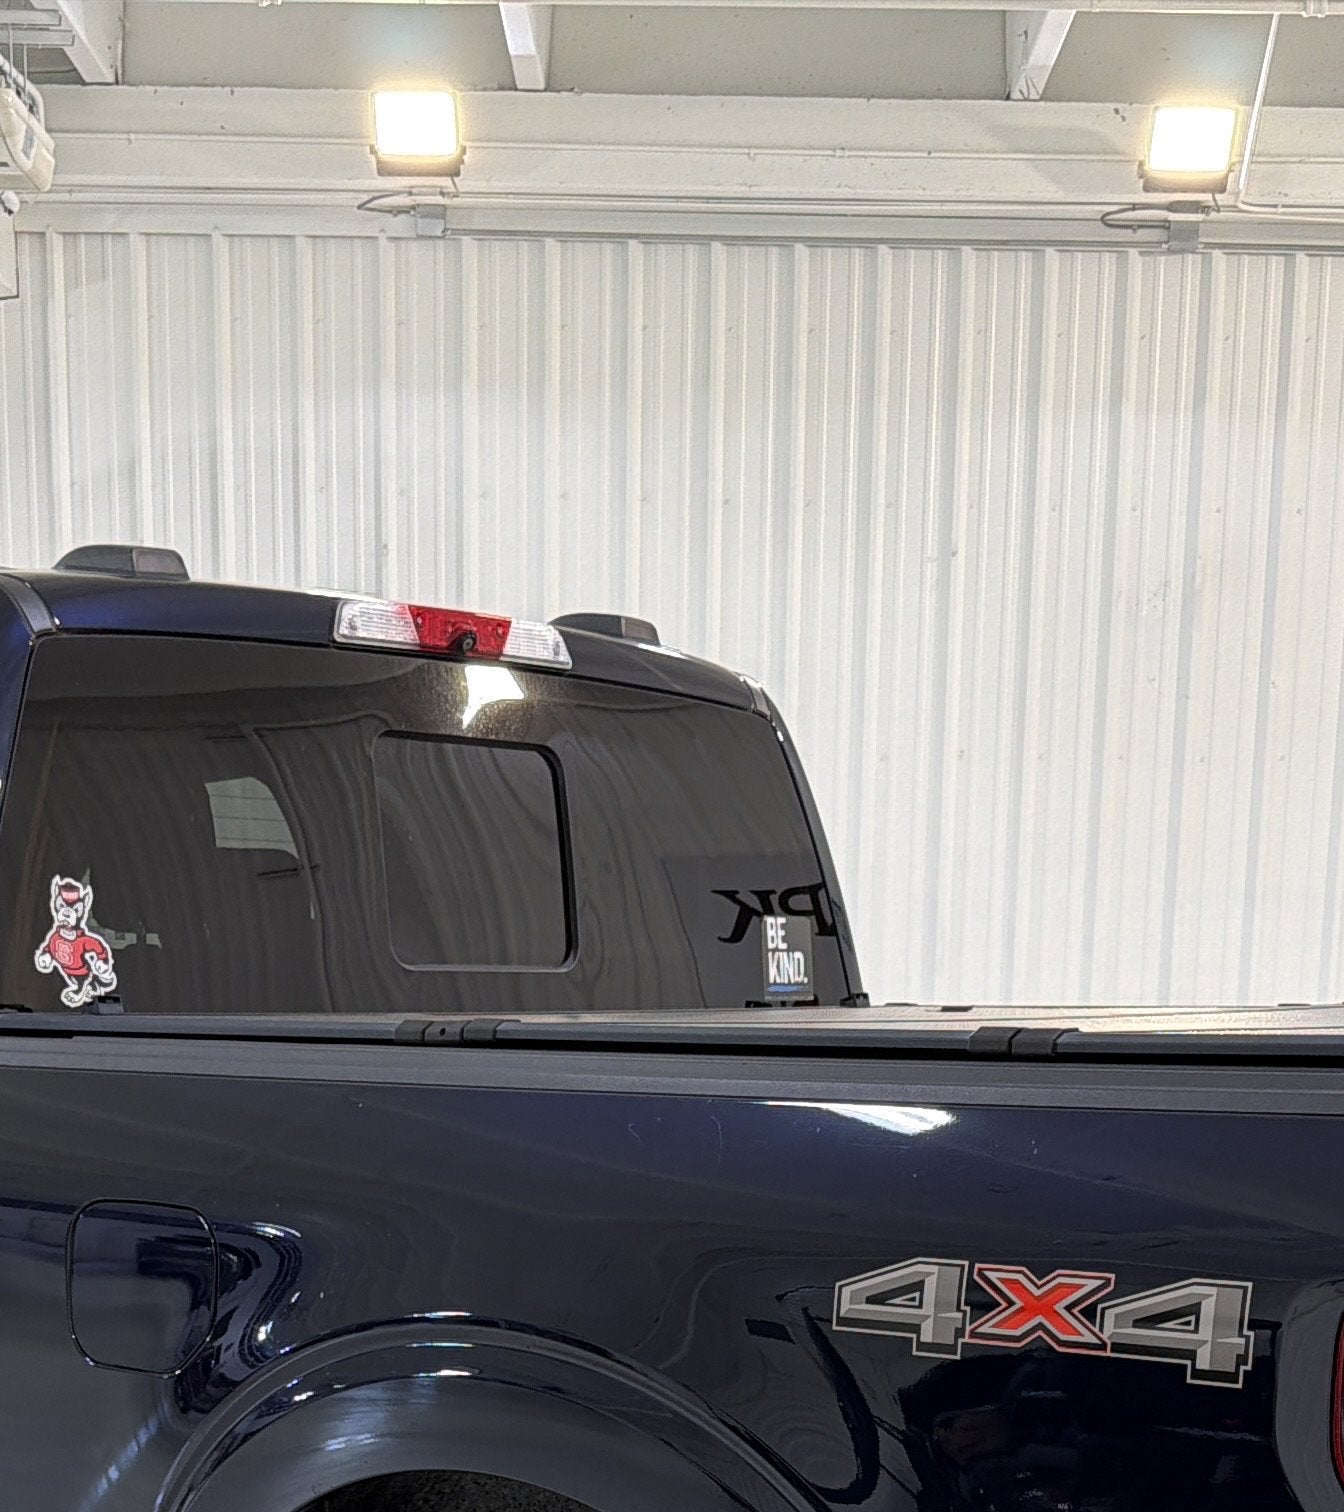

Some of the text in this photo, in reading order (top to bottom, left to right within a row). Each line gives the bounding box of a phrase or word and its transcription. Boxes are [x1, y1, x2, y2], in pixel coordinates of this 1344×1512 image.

[766, 916, 788, 949] BE
[767, 951, 808, 984] KIND.
[833, 1257, 1254, 1388] 4X4
